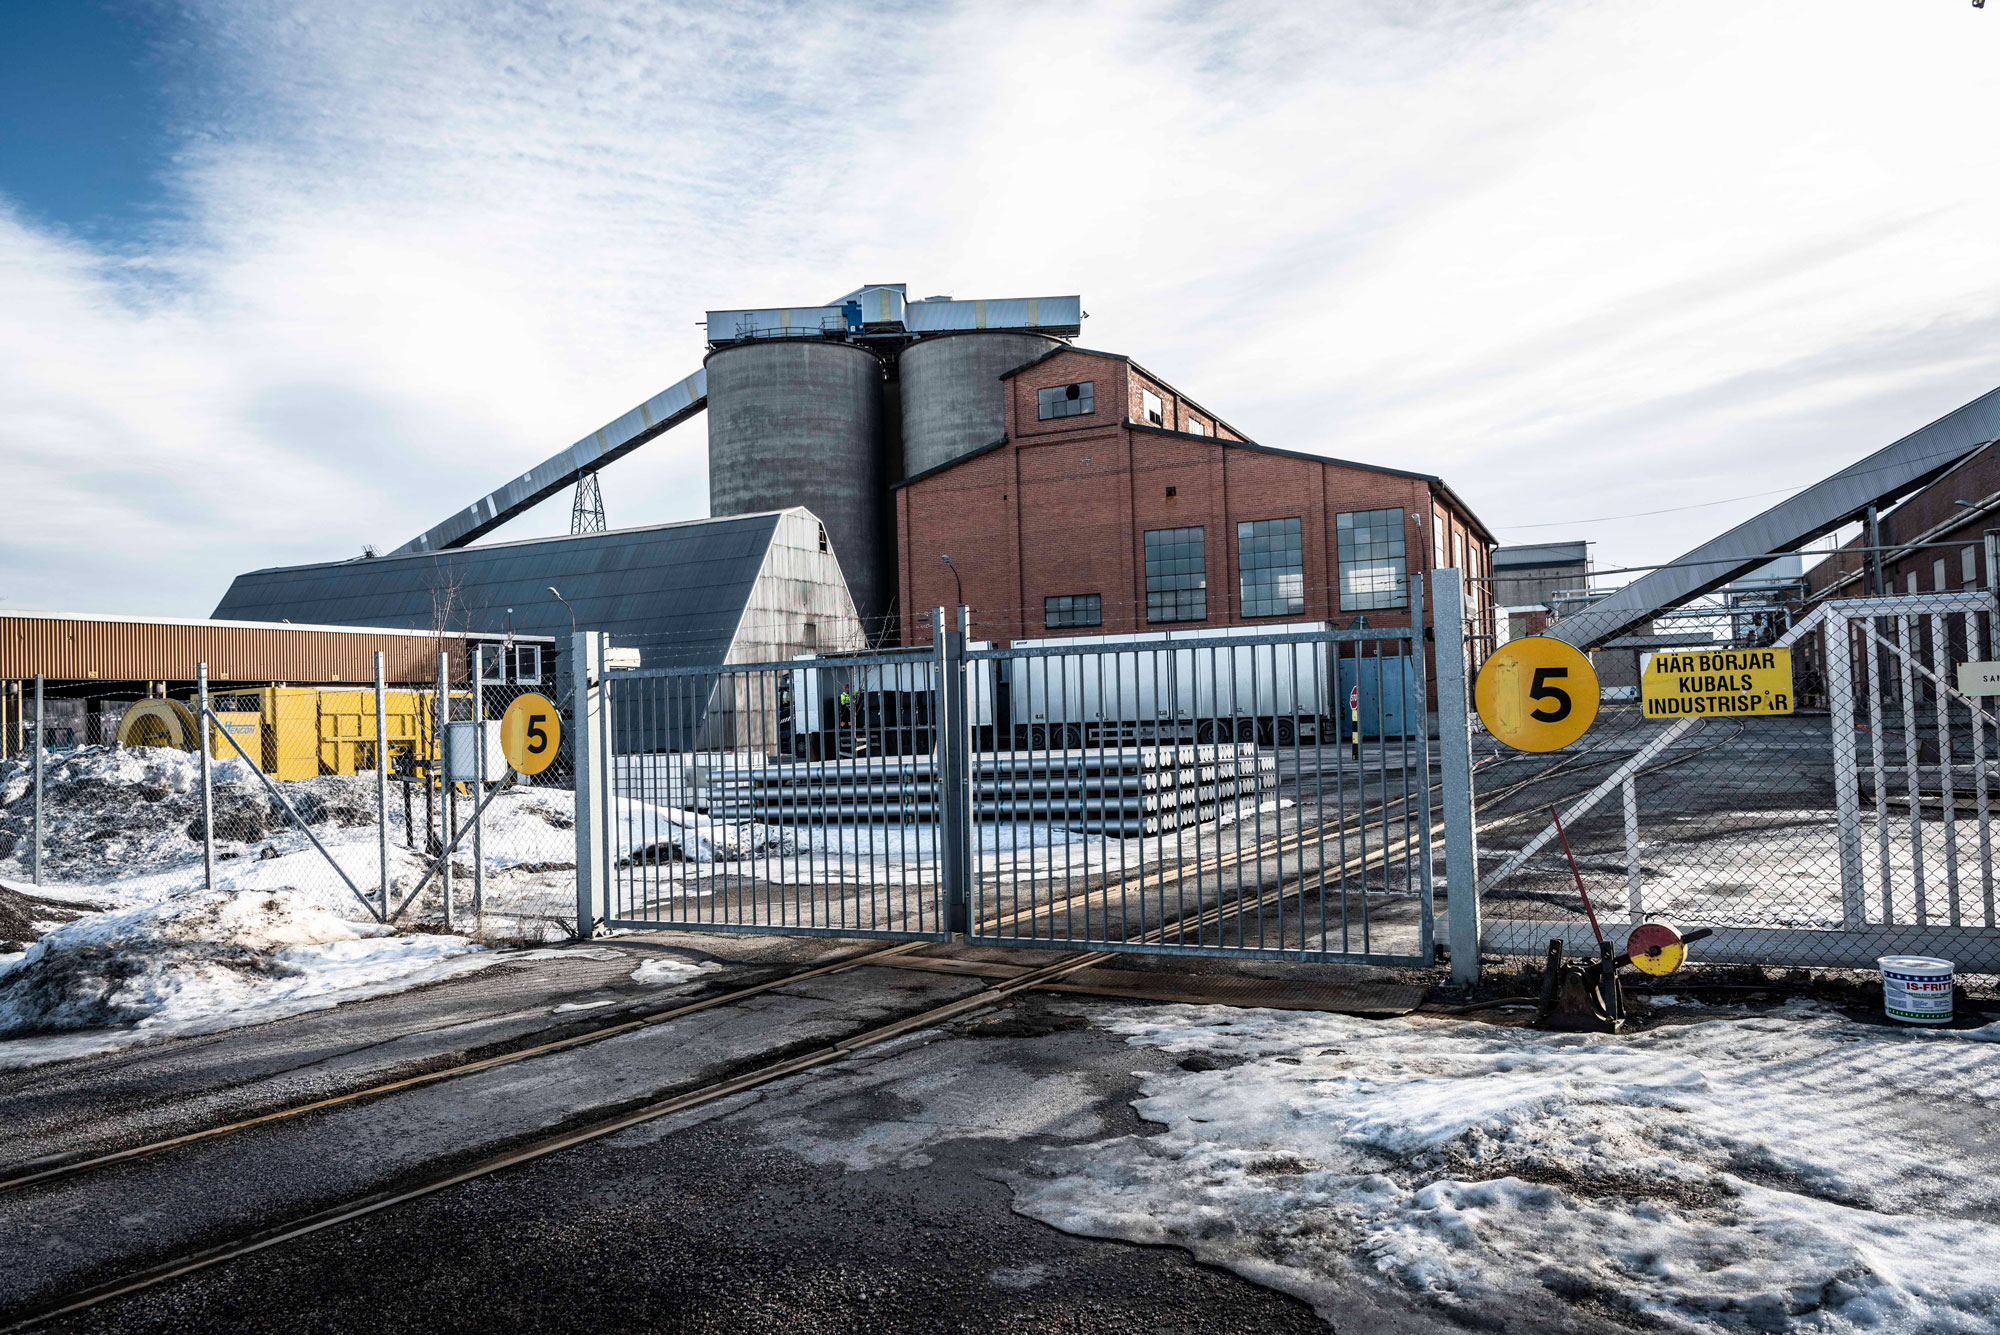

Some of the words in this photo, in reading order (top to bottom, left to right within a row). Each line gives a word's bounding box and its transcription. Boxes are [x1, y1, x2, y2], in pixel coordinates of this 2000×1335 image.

[1656, 653, 1694, 673] HÄR
[1700, 651, 1775, 672] BÖRJAR
[1679, 674, 1753, 693] KUBALS
[1529, 667, 1572, 723] 5
[527, 714, 548, 755] 5
[1906, 982, 1952, 991] IS-FRITT
